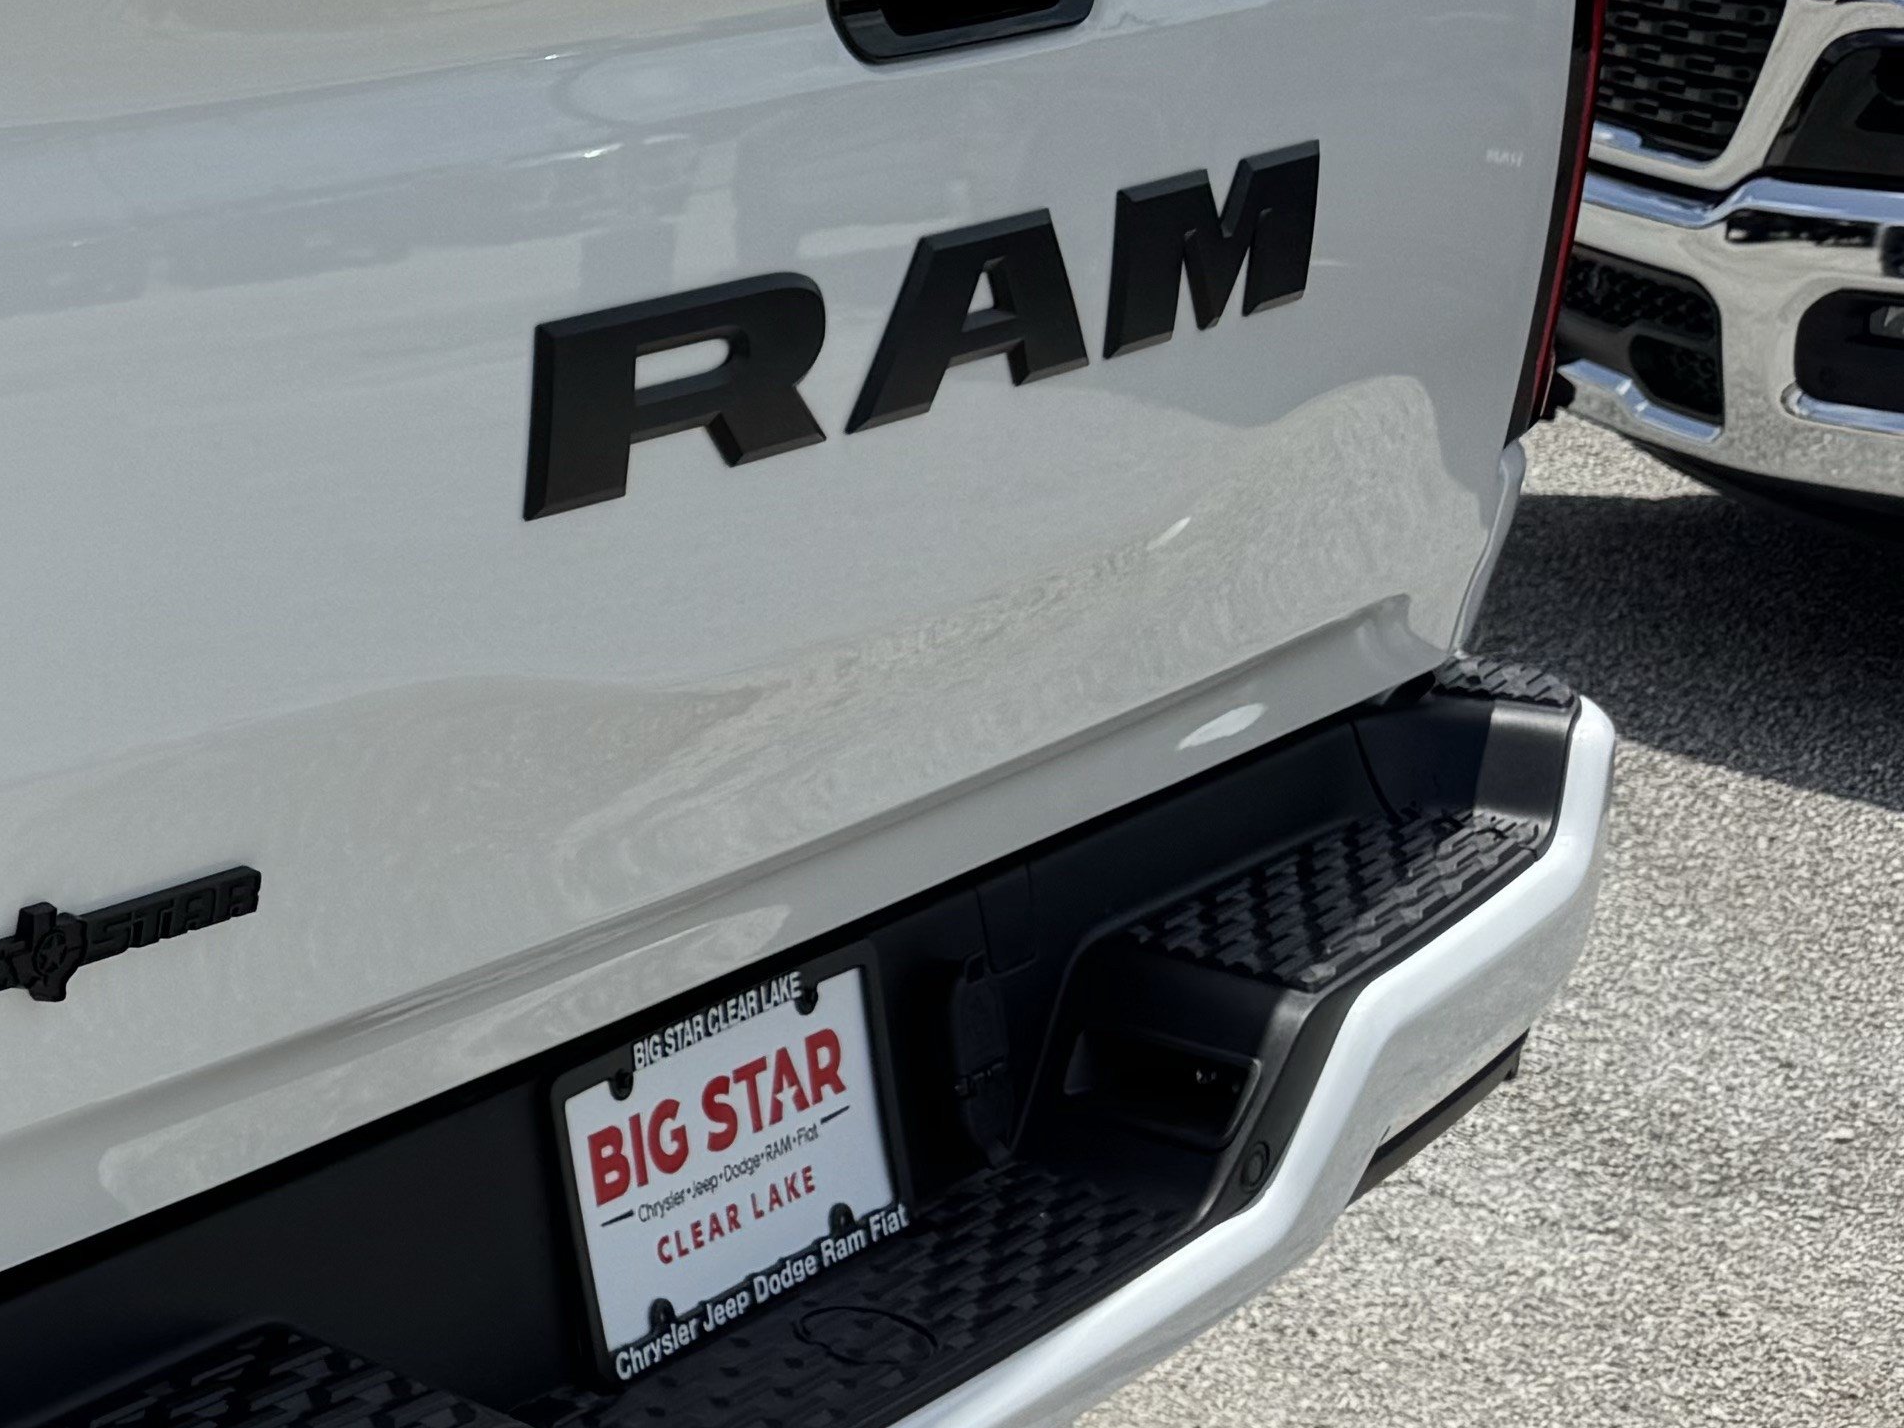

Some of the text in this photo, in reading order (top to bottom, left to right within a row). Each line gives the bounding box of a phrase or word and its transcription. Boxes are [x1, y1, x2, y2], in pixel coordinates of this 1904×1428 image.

[524, 139, 1320, 522] RAM
[82, 865, 261, 966] STAR
[633, 972, 802, 1071] BIG STAR CLEAR LAKE
[588, 1028, 846, 1206] BIG STAR
[657, 1165, 816, 1264] CLEAR LAKE
[615, 1204, 909, 1380] Chrysler Jeep Dodge Ram Fiat
